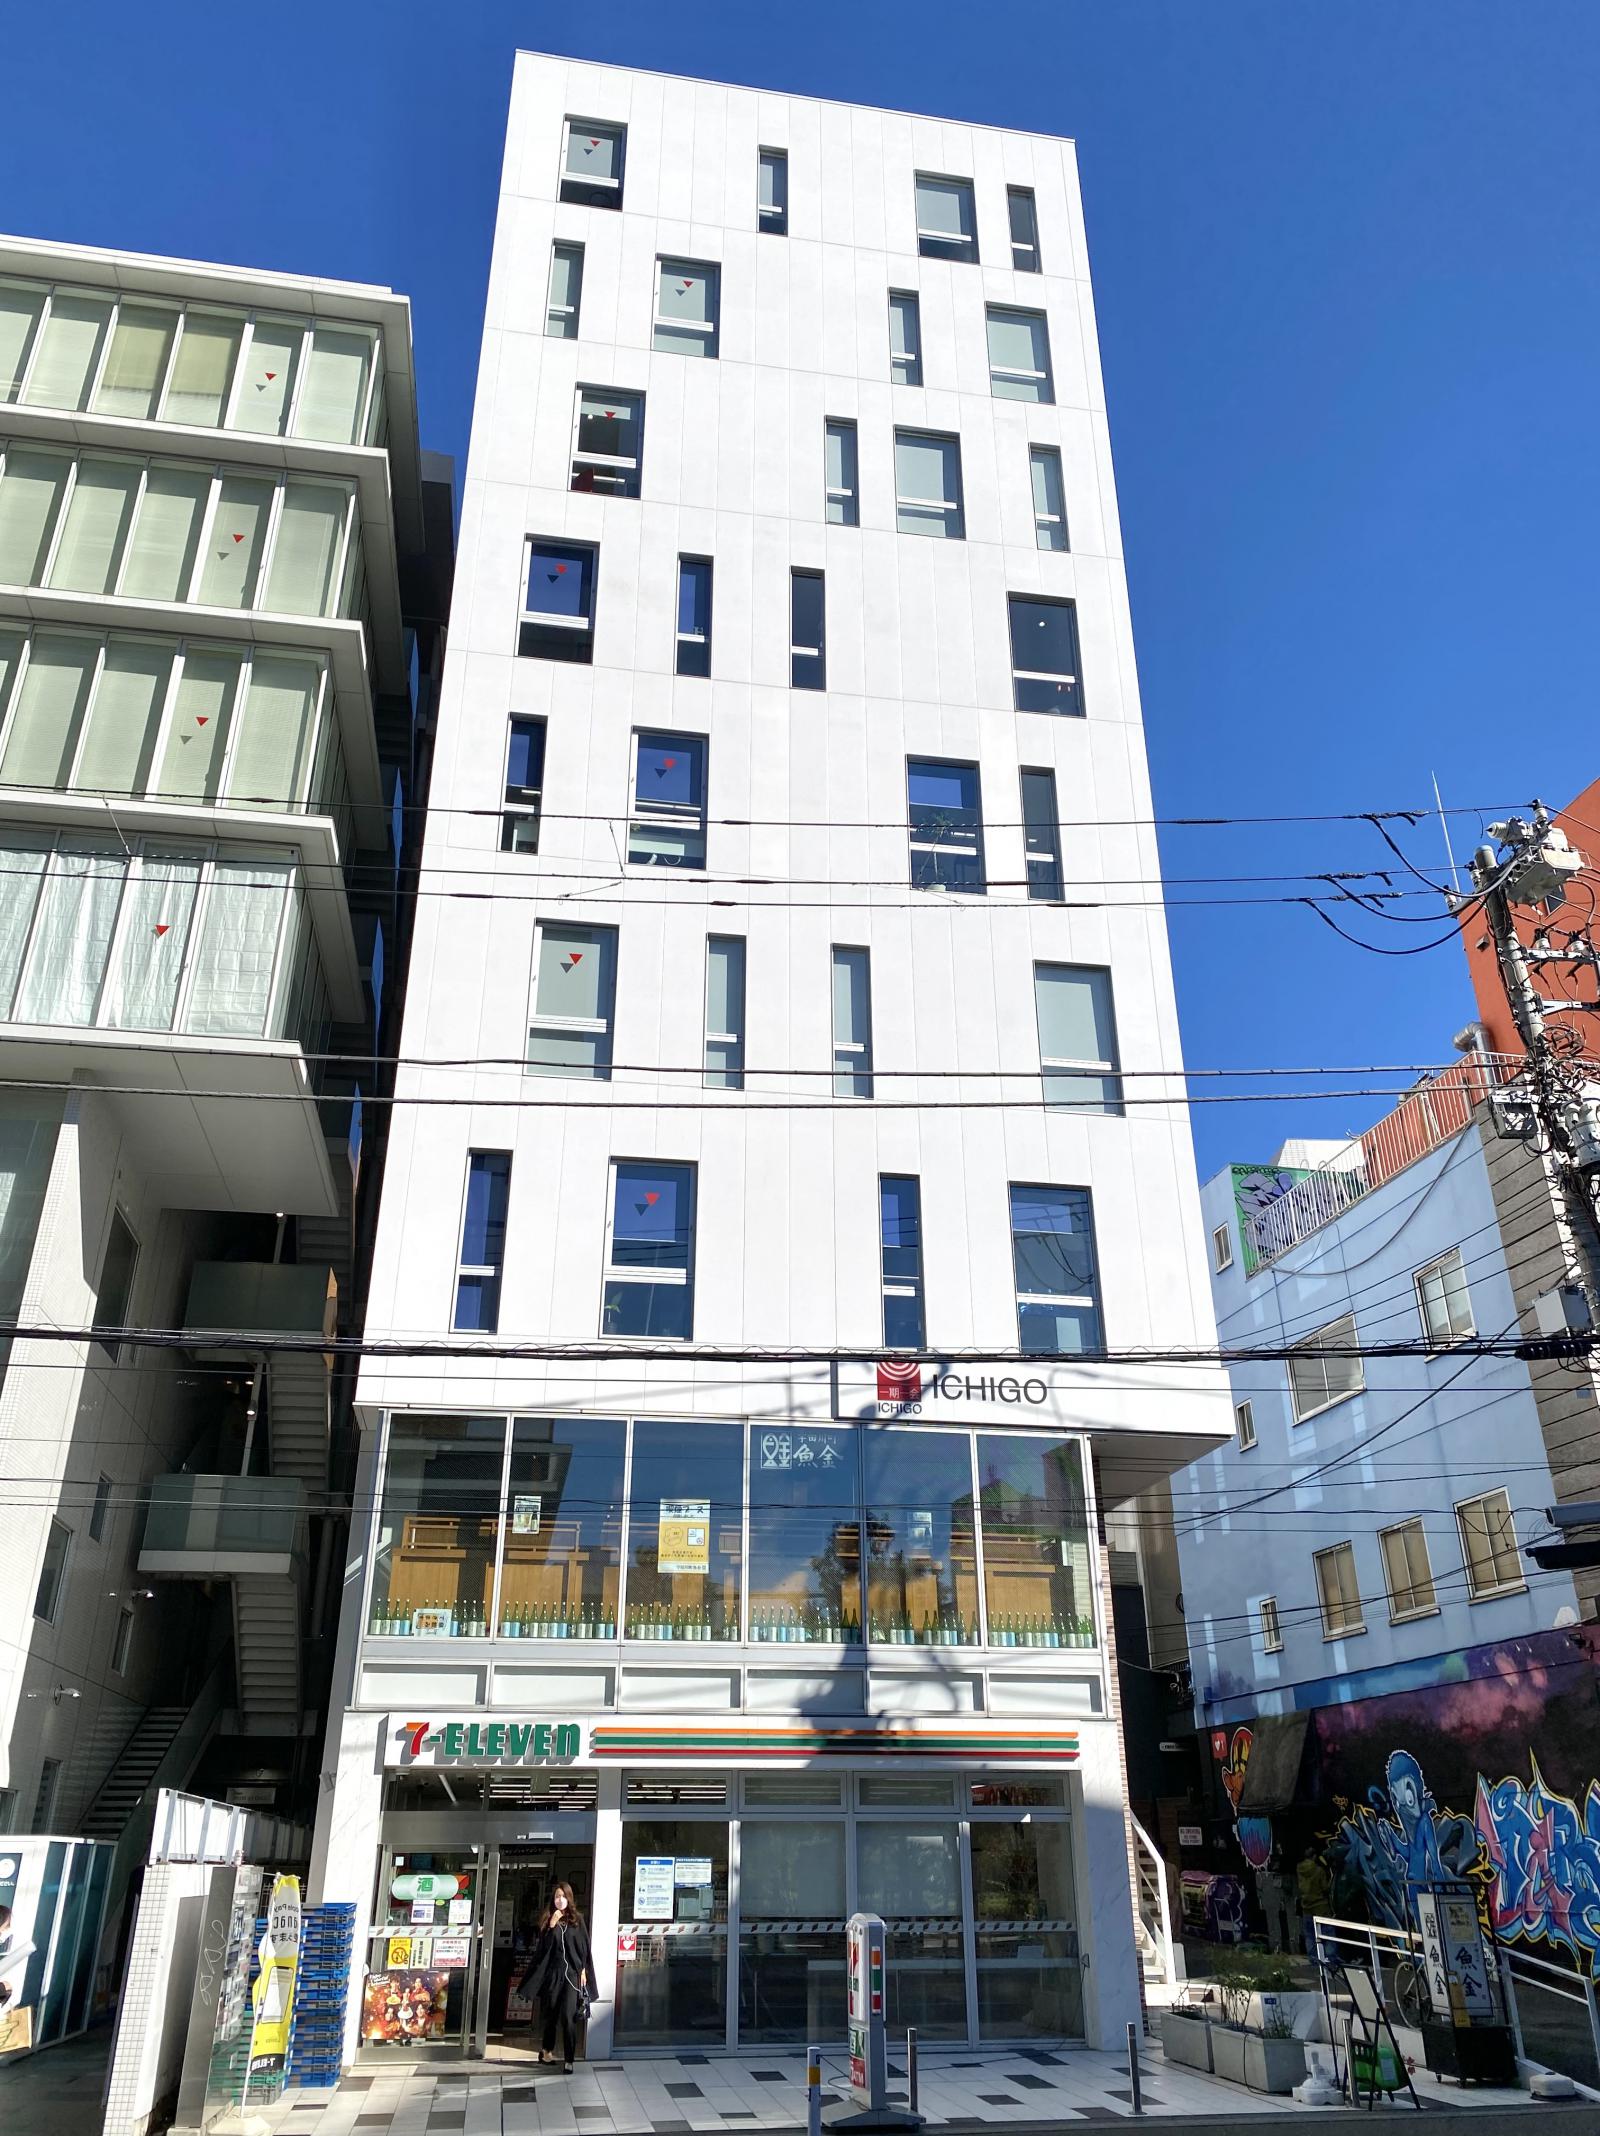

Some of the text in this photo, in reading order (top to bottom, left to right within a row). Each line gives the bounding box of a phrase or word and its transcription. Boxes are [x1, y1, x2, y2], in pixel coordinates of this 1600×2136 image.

[879, 1387, 921, 1399] 一期一会
[932, 1374, 1048, 1405] ICHIGO
[877, 1402, 922, 1415] ICHIGO
[793, 1443, 844, 1469] 魚金
[417, 1877, 434, 1892] 酒
[1429, 1944, 1447, 1995] 魚金
[1455, 1946, 1483, 1997] 魚金
